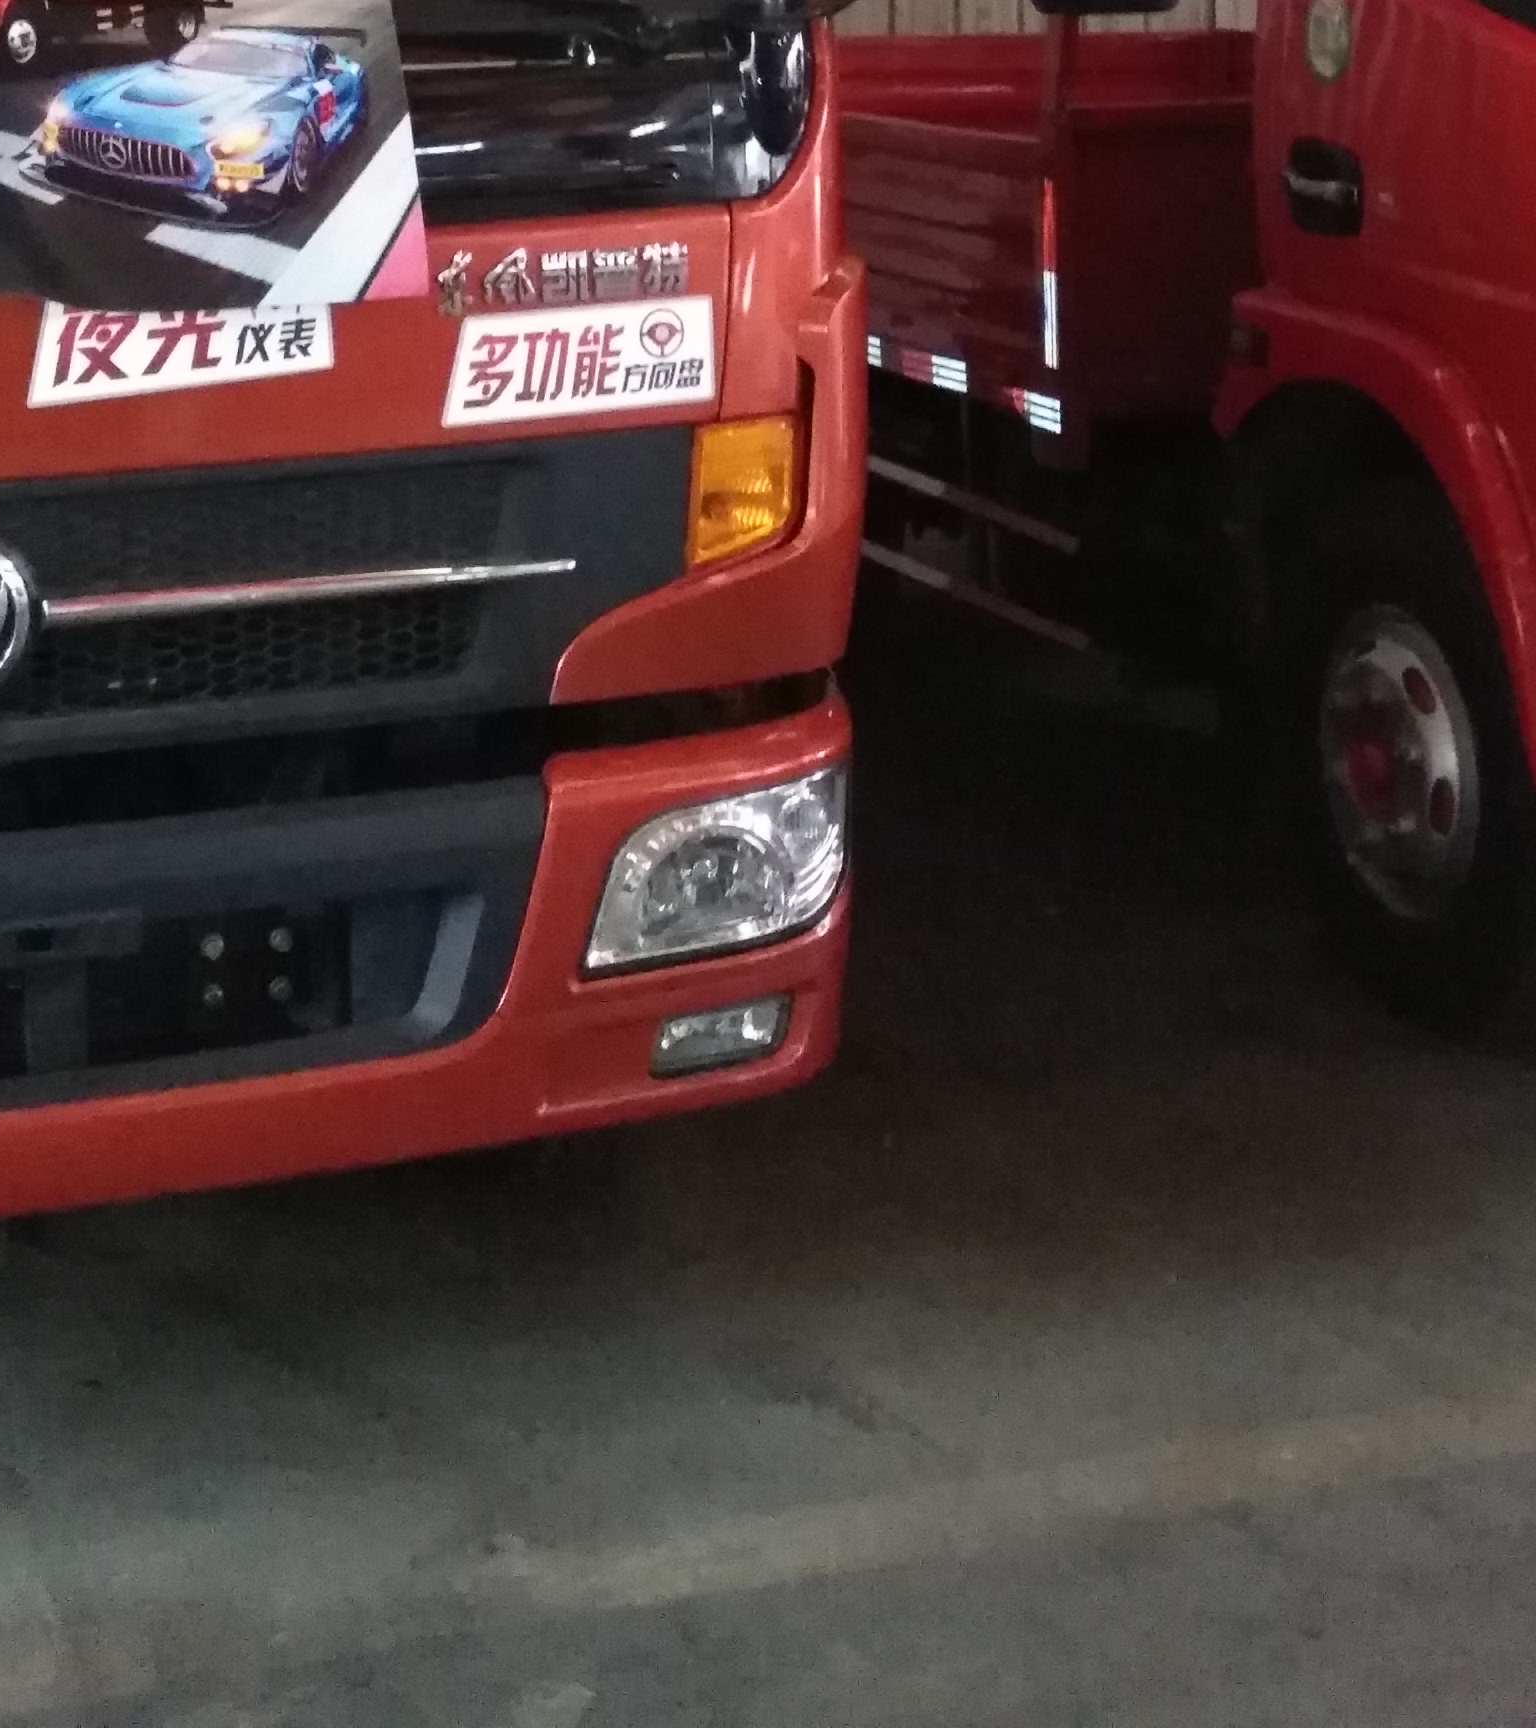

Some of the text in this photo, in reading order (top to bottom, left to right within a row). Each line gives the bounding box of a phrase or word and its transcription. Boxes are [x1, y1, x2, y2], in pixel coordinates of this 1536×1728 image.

[463, 322, 625, 409] 多功能
[620, 357, 705, 394] 方向盘
